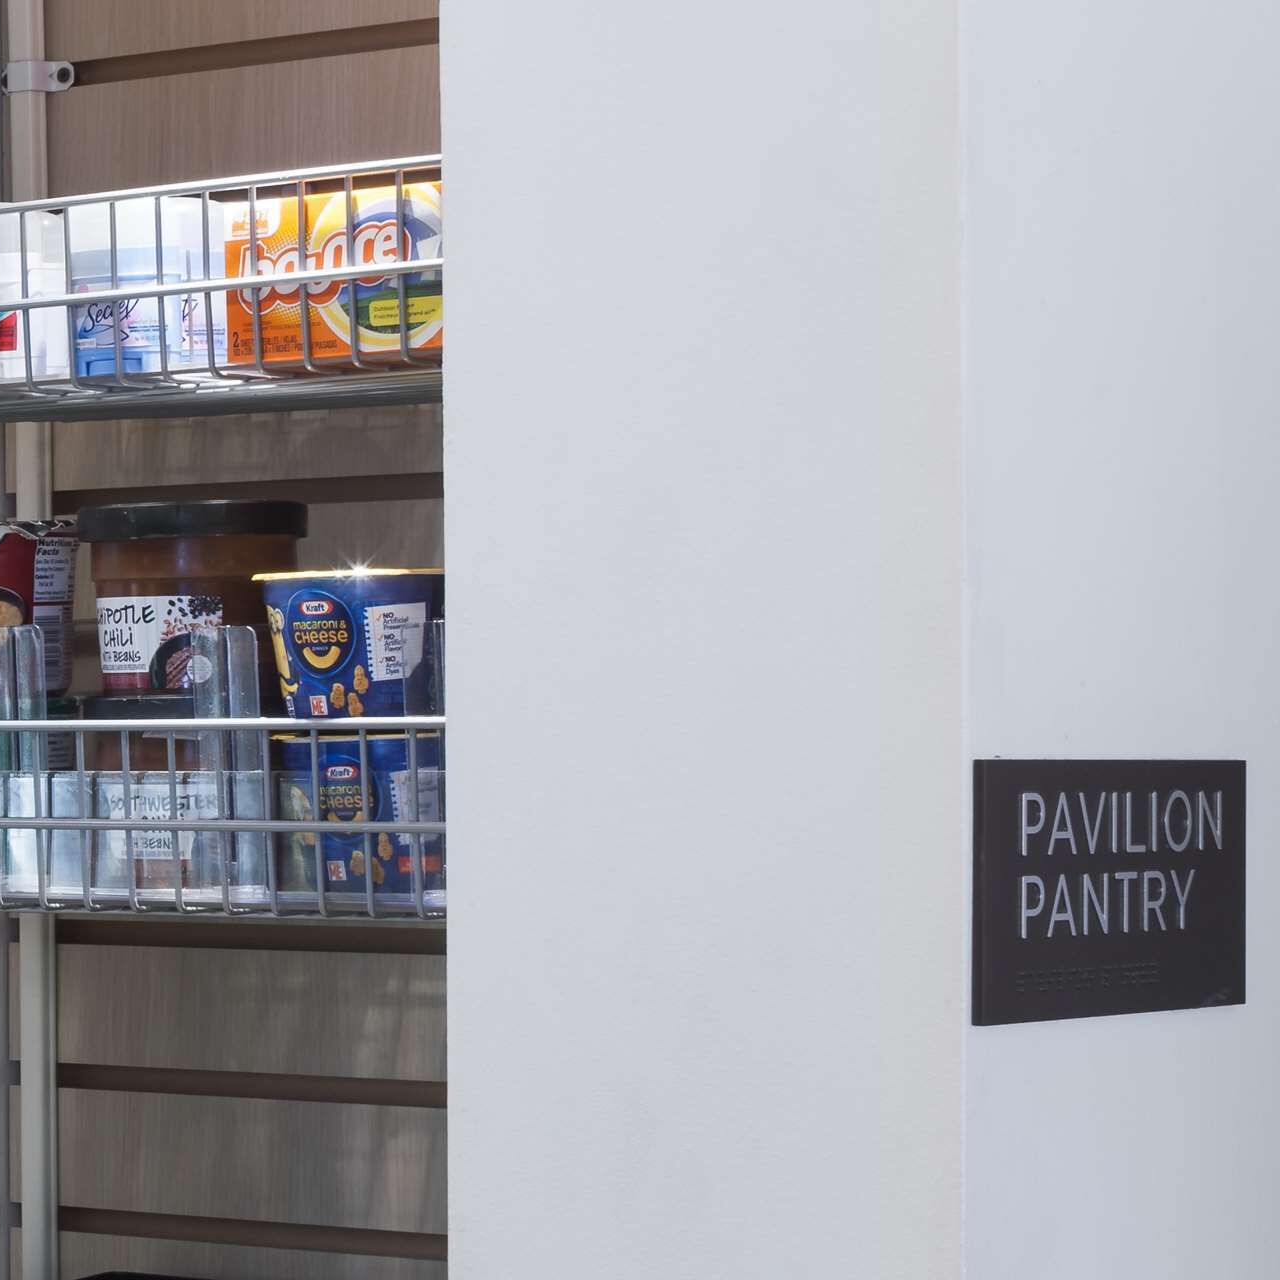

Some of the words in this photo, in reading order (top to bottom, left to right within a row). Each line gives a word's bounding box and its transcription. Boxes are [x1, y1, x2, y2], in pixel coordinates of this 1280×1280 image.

[305, 602, 326, 613] Kraft
[293, 620, 338, 631] macaroni
[330, 766, 351, 778] Kraft
[1020, 790, 1223, 856] PAVILION
[1020, 869, 1196, 939] PANTRY
